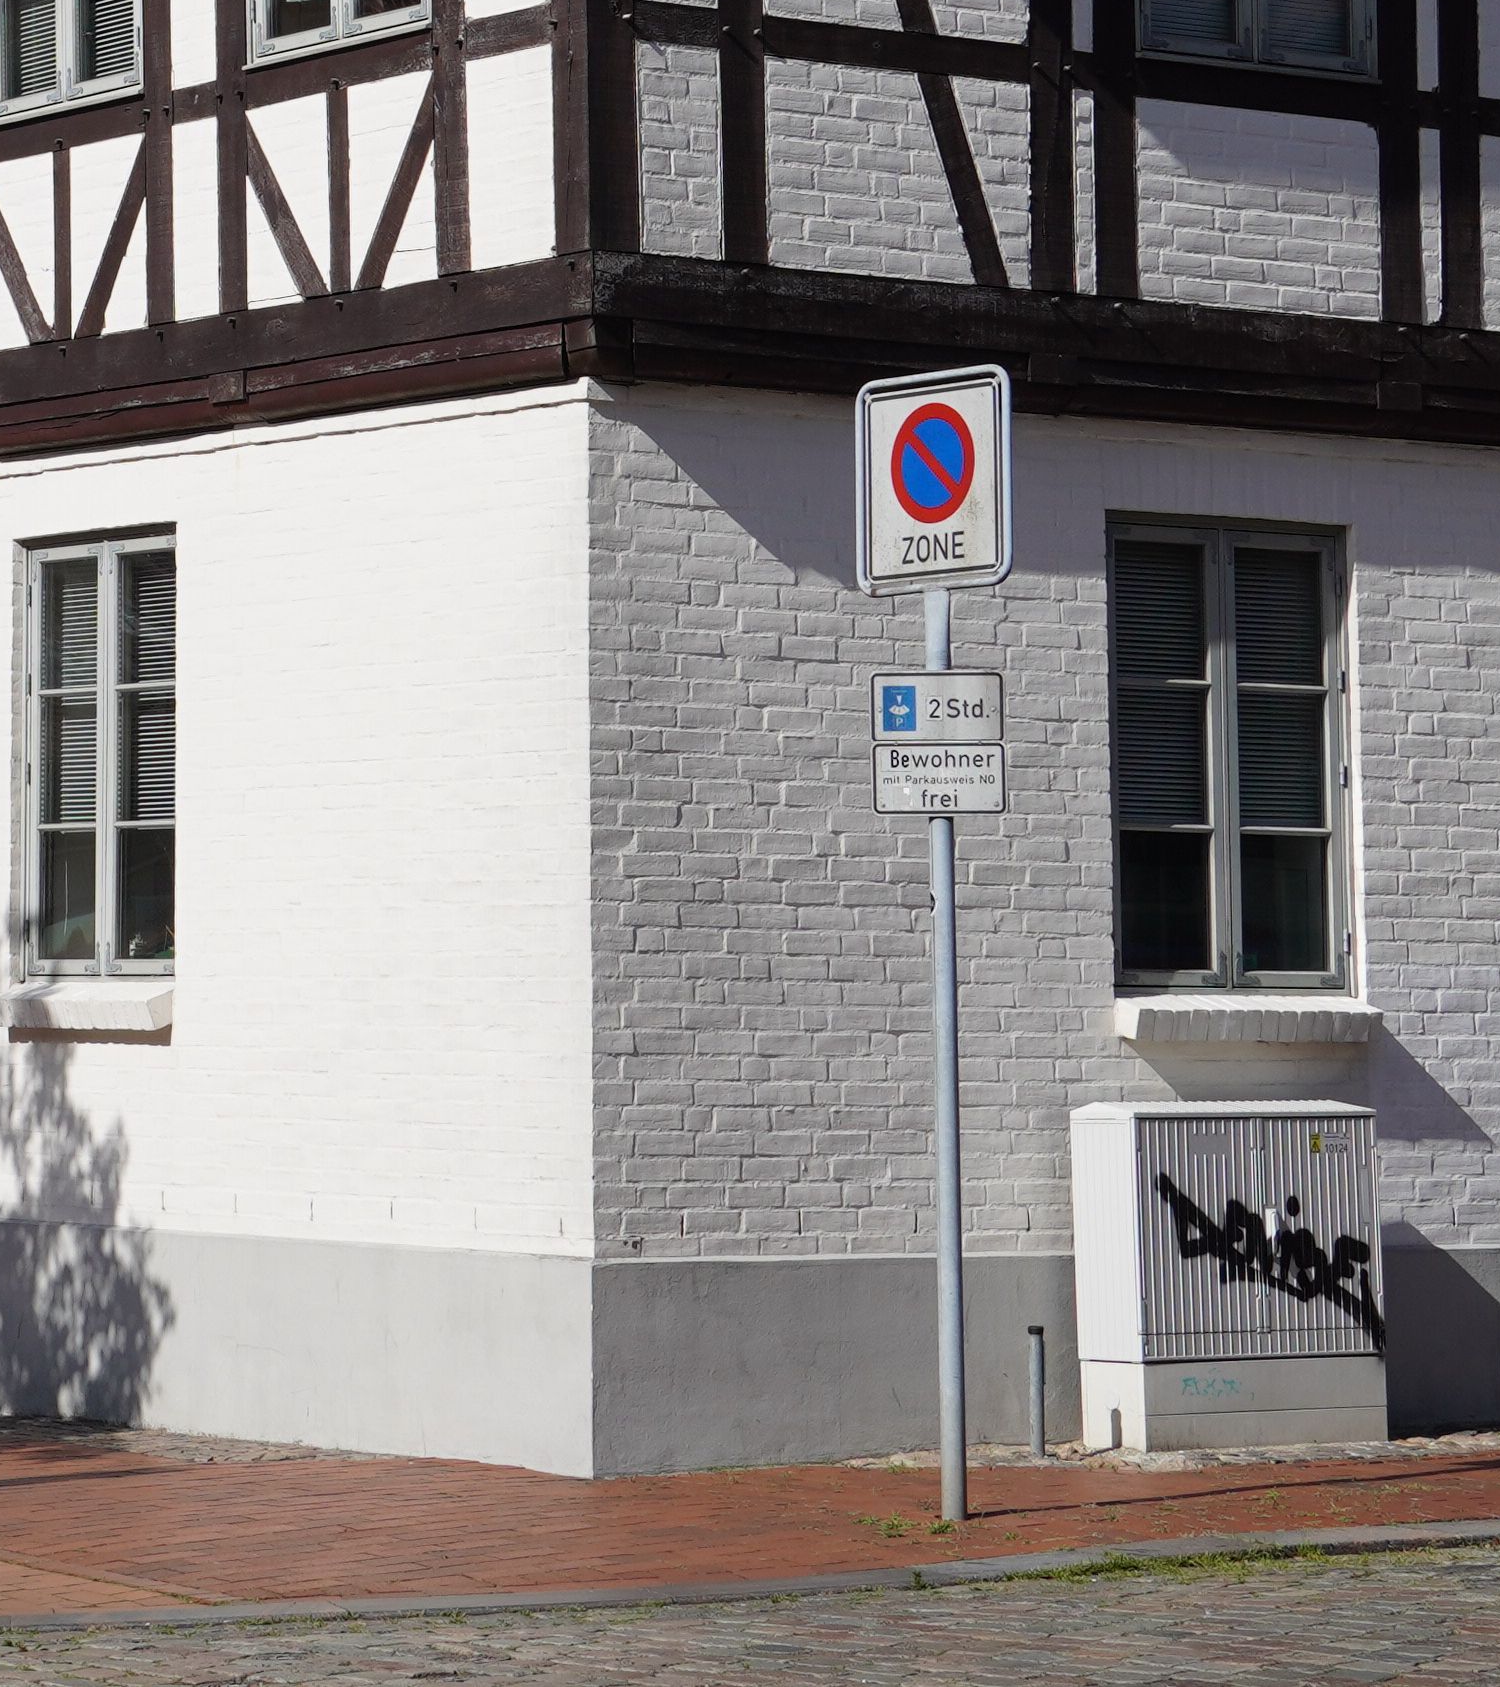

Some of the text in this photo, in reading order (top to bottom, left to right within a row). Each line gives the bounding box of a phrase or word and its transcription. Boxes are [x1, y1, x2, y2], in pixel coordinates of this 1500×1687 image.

[902, 530, 965, 565] ZONE
[928, 697, 990, 719] 2 Std.
[890, 749, 996, 768] Bewohner
[883, 775, 900, 785] mit
[904, 774, 975, 785] Parkausweis
[921, 789, 959, 808] frei
[1324, 1143, 1349, 1154] 10124
